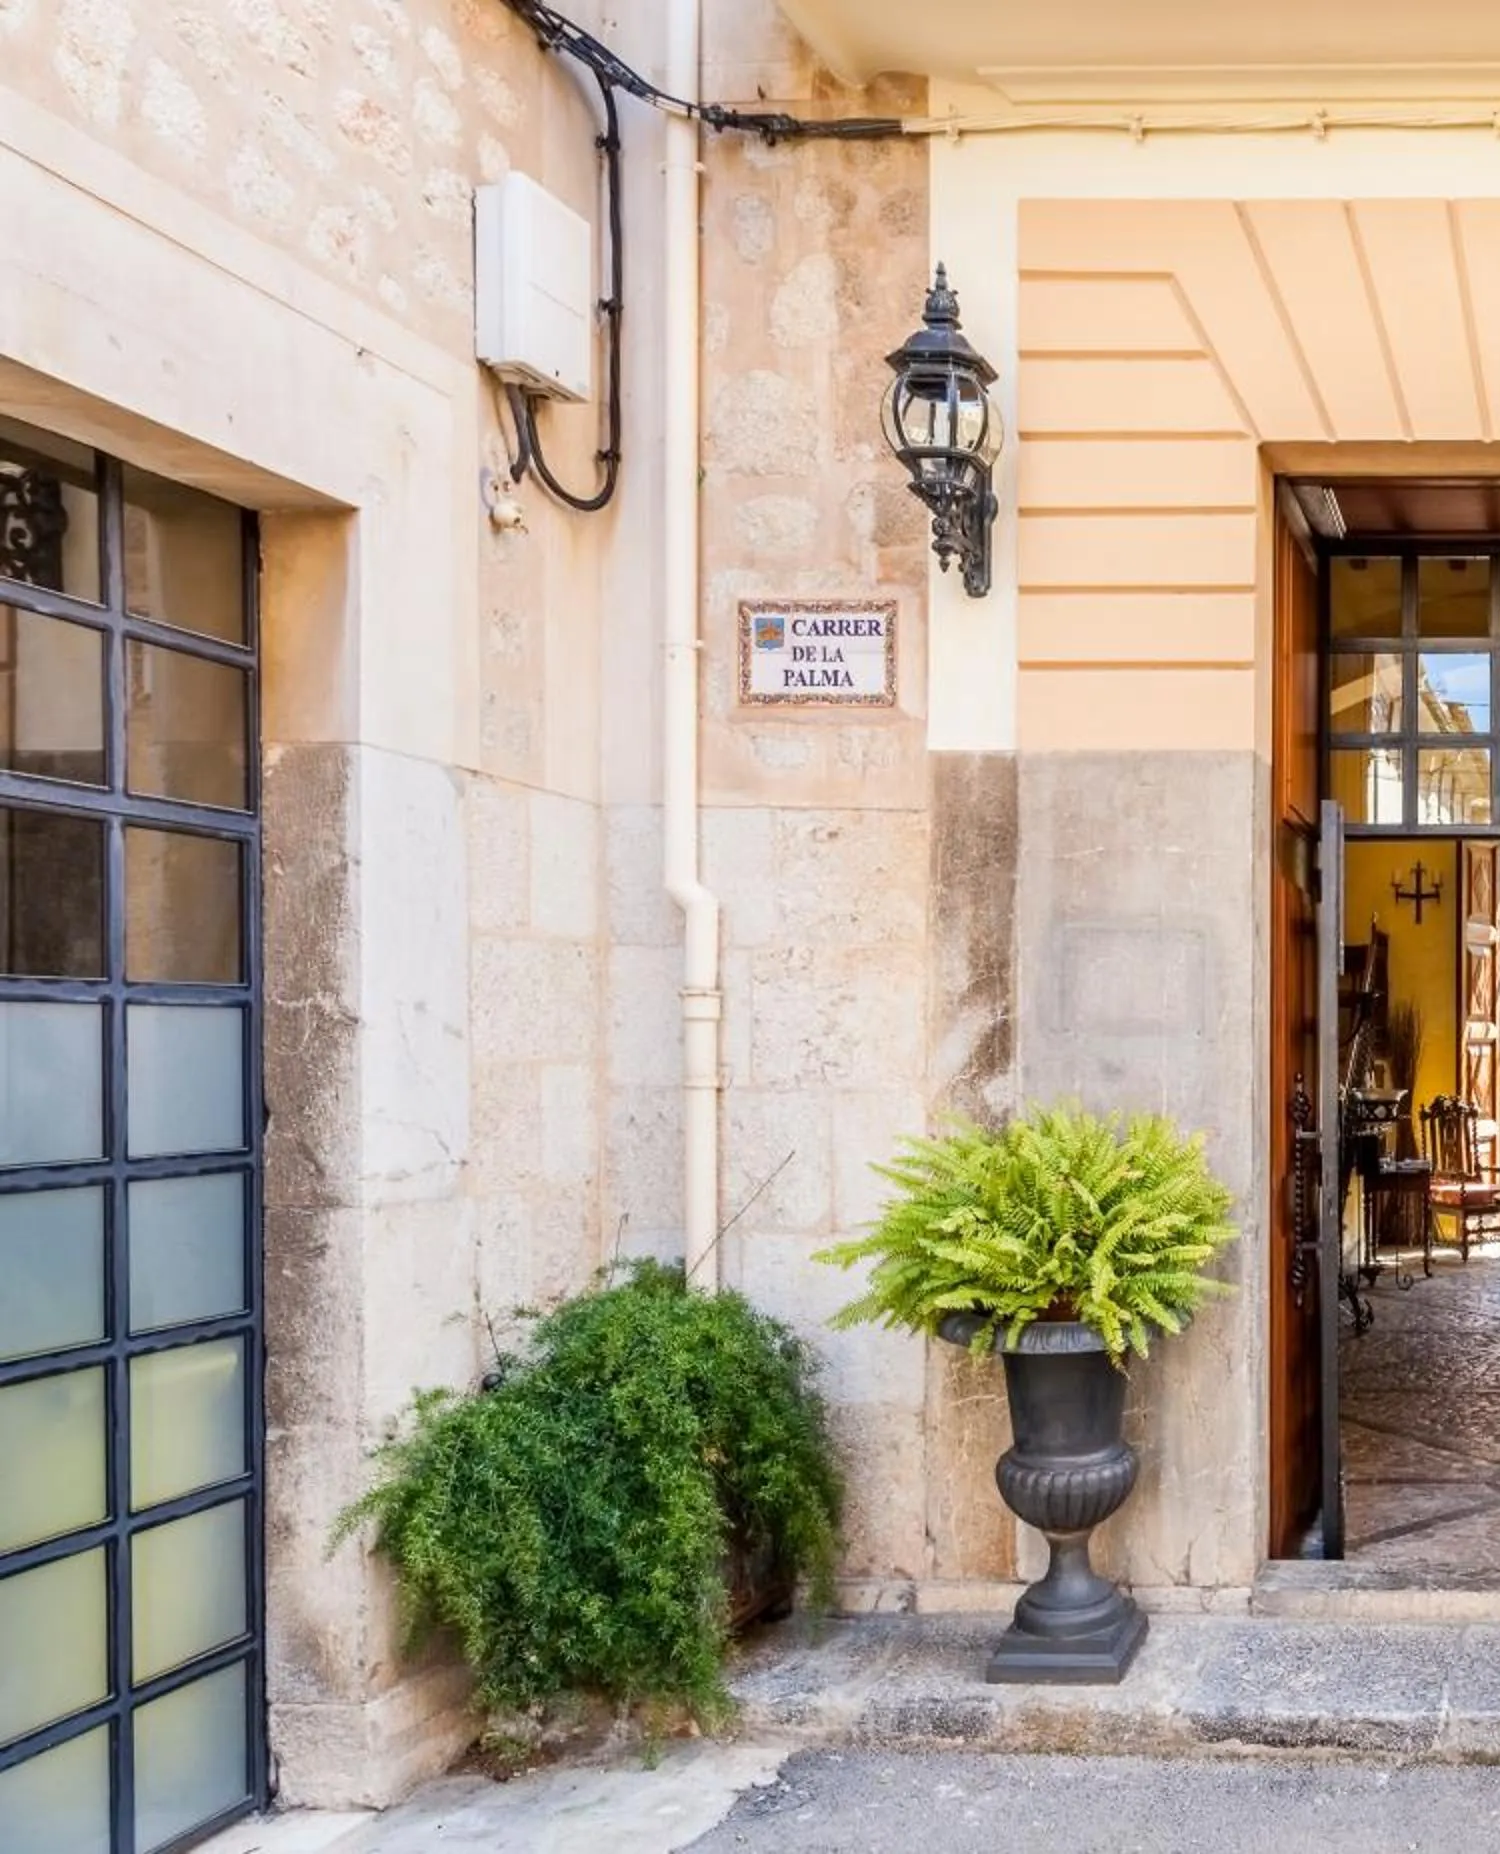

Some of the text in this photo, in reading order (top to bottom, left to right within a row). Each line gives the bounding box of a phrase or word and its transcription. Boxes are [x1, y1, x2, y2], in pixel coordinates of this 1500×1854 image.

[791, 619, 883, 636] CARRER
[792, 646, 844, 662] DE LA
[783, 669, 854, 687] PALMA
